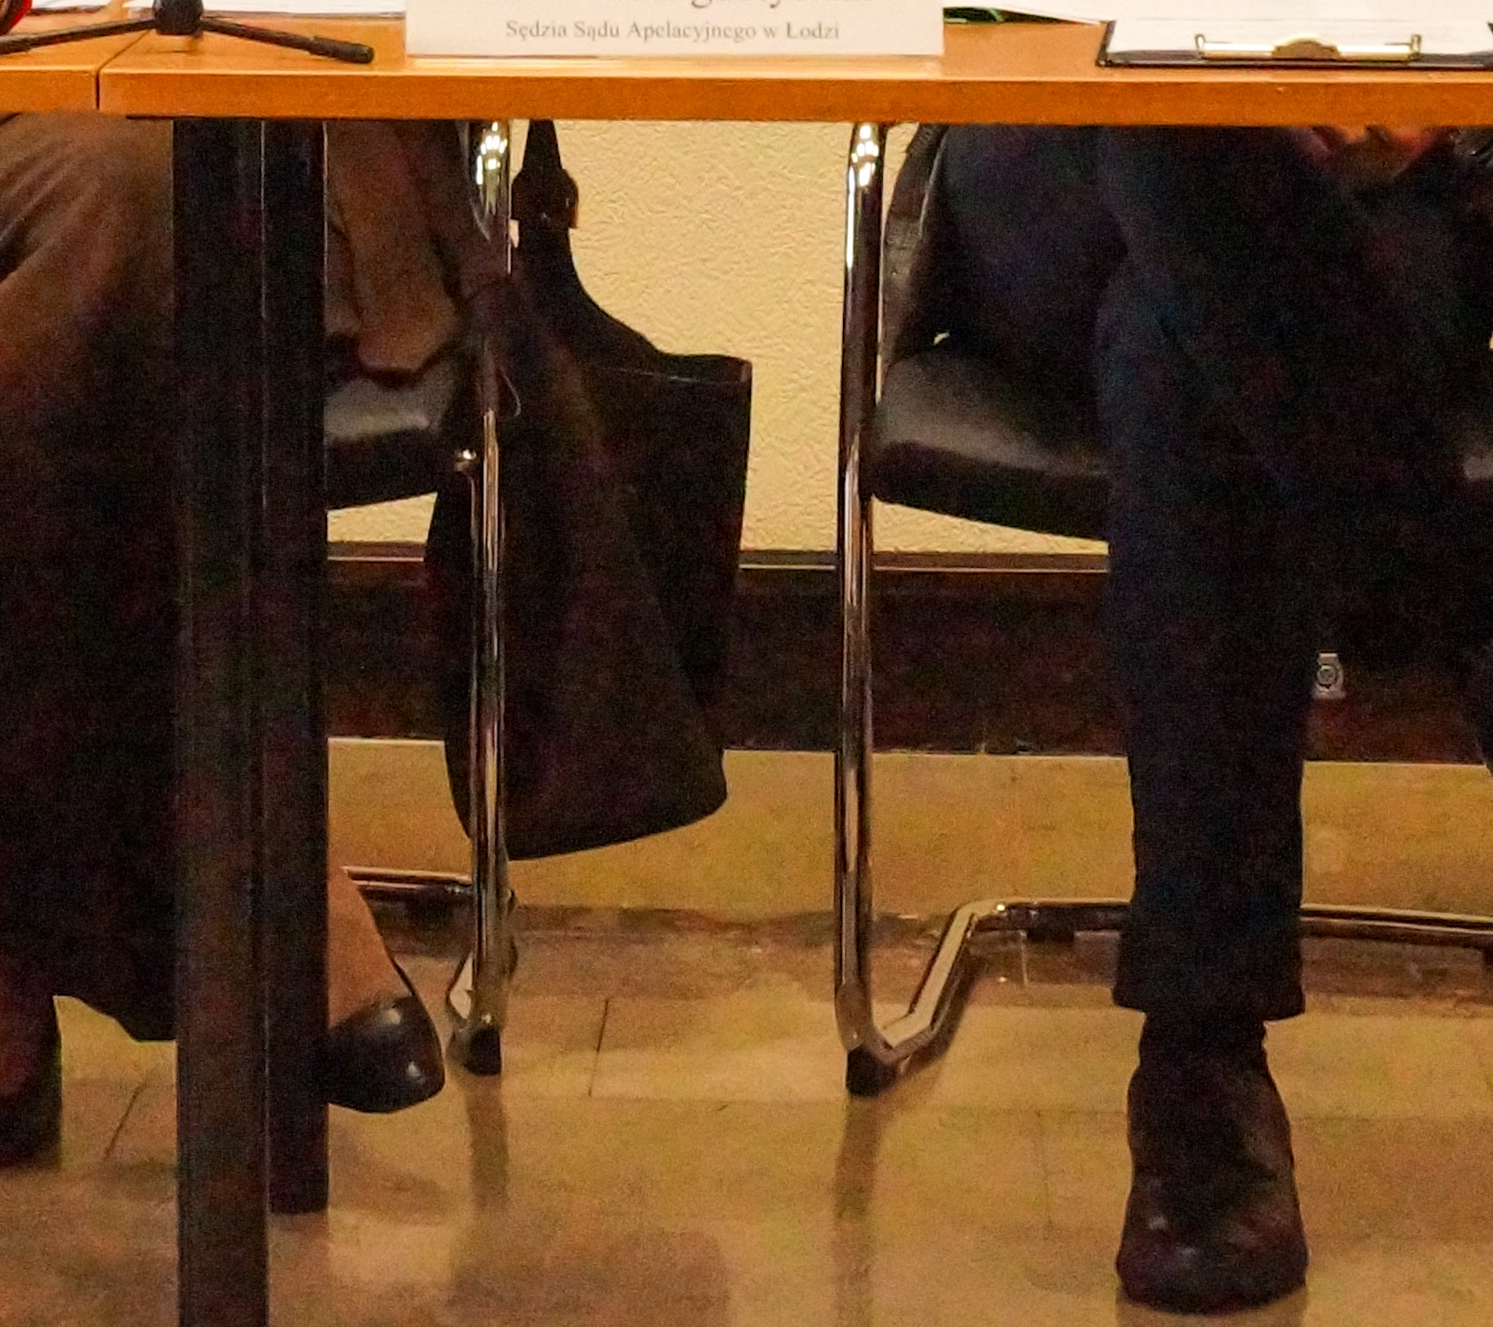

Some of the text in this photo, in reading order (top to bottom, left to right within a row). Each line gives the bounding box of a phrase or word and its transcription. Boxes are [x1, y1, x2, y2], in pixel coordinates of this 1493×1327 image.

[505, 20, 840, 44] Sędzia Sądu Apelacyjnego w Łodzi
